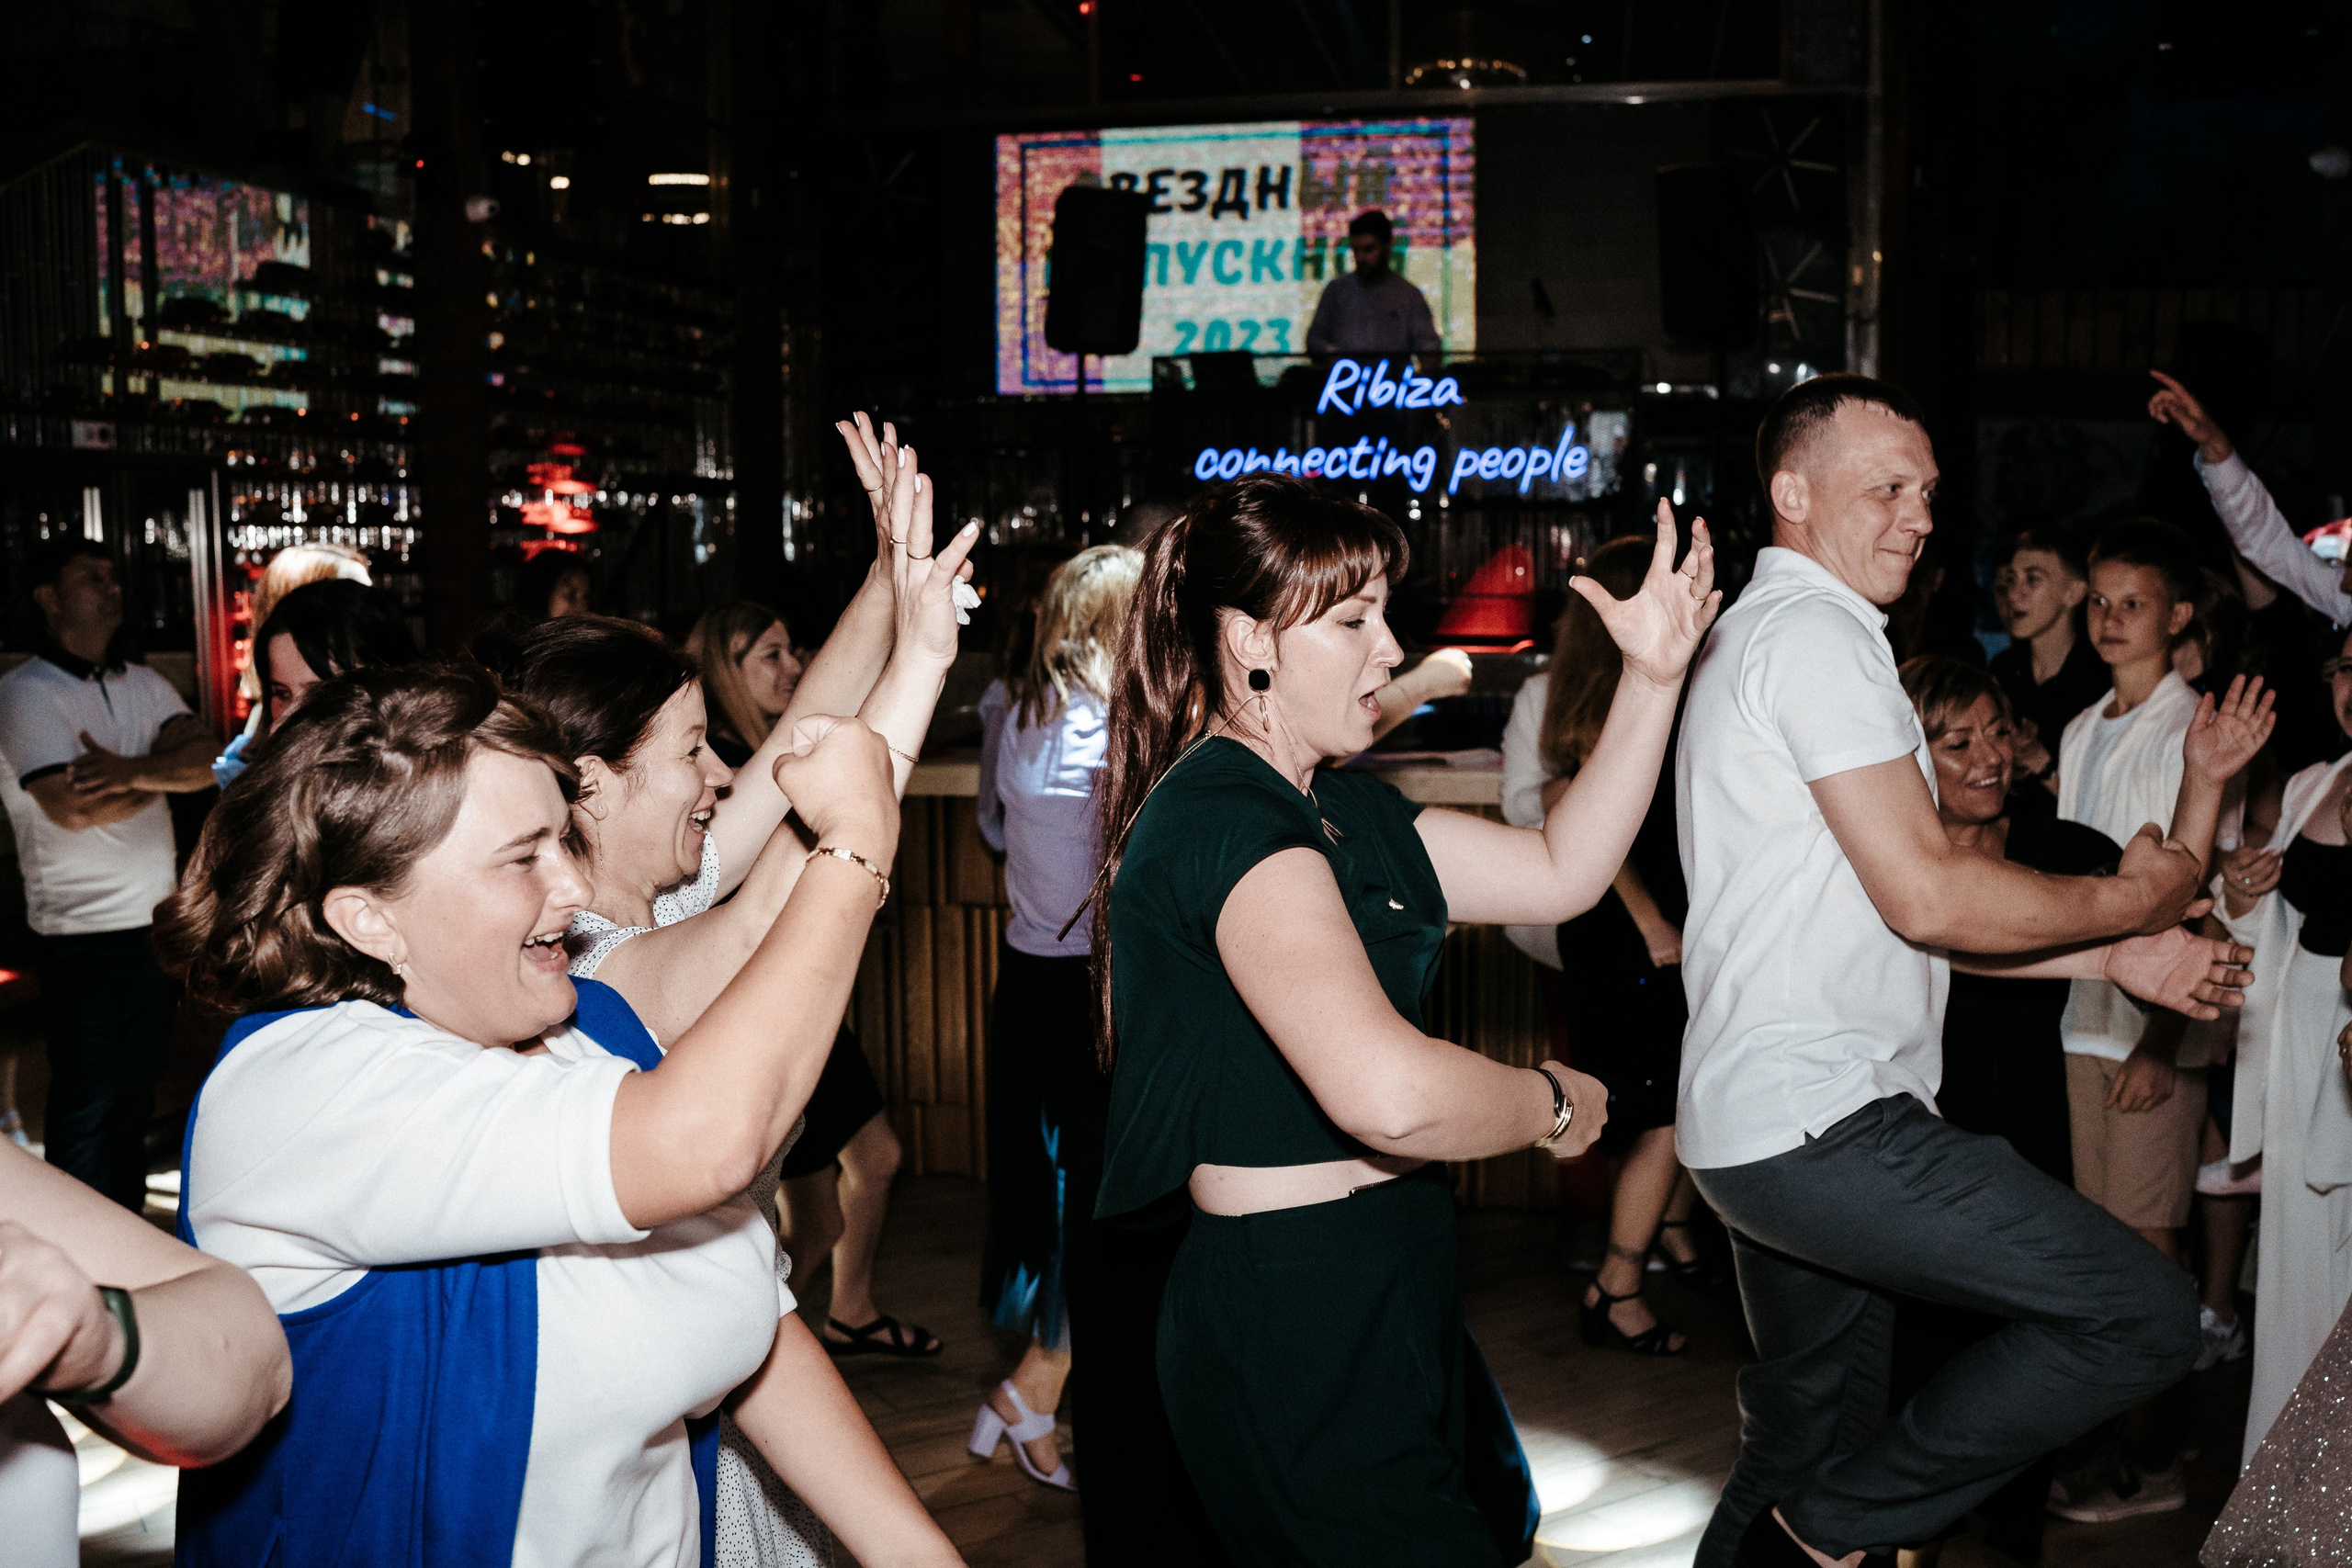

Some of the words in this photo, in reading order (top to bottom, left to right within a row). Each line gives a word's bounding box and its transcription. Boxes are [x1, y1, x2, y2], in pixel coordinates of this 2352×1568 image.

[1173, 318, 1290, 355] 2023
[1317, 359, 1463, 415] Ribiza
[1194, 435, 1436, 492] connecting
[1448, 425, 1588, 494] people
